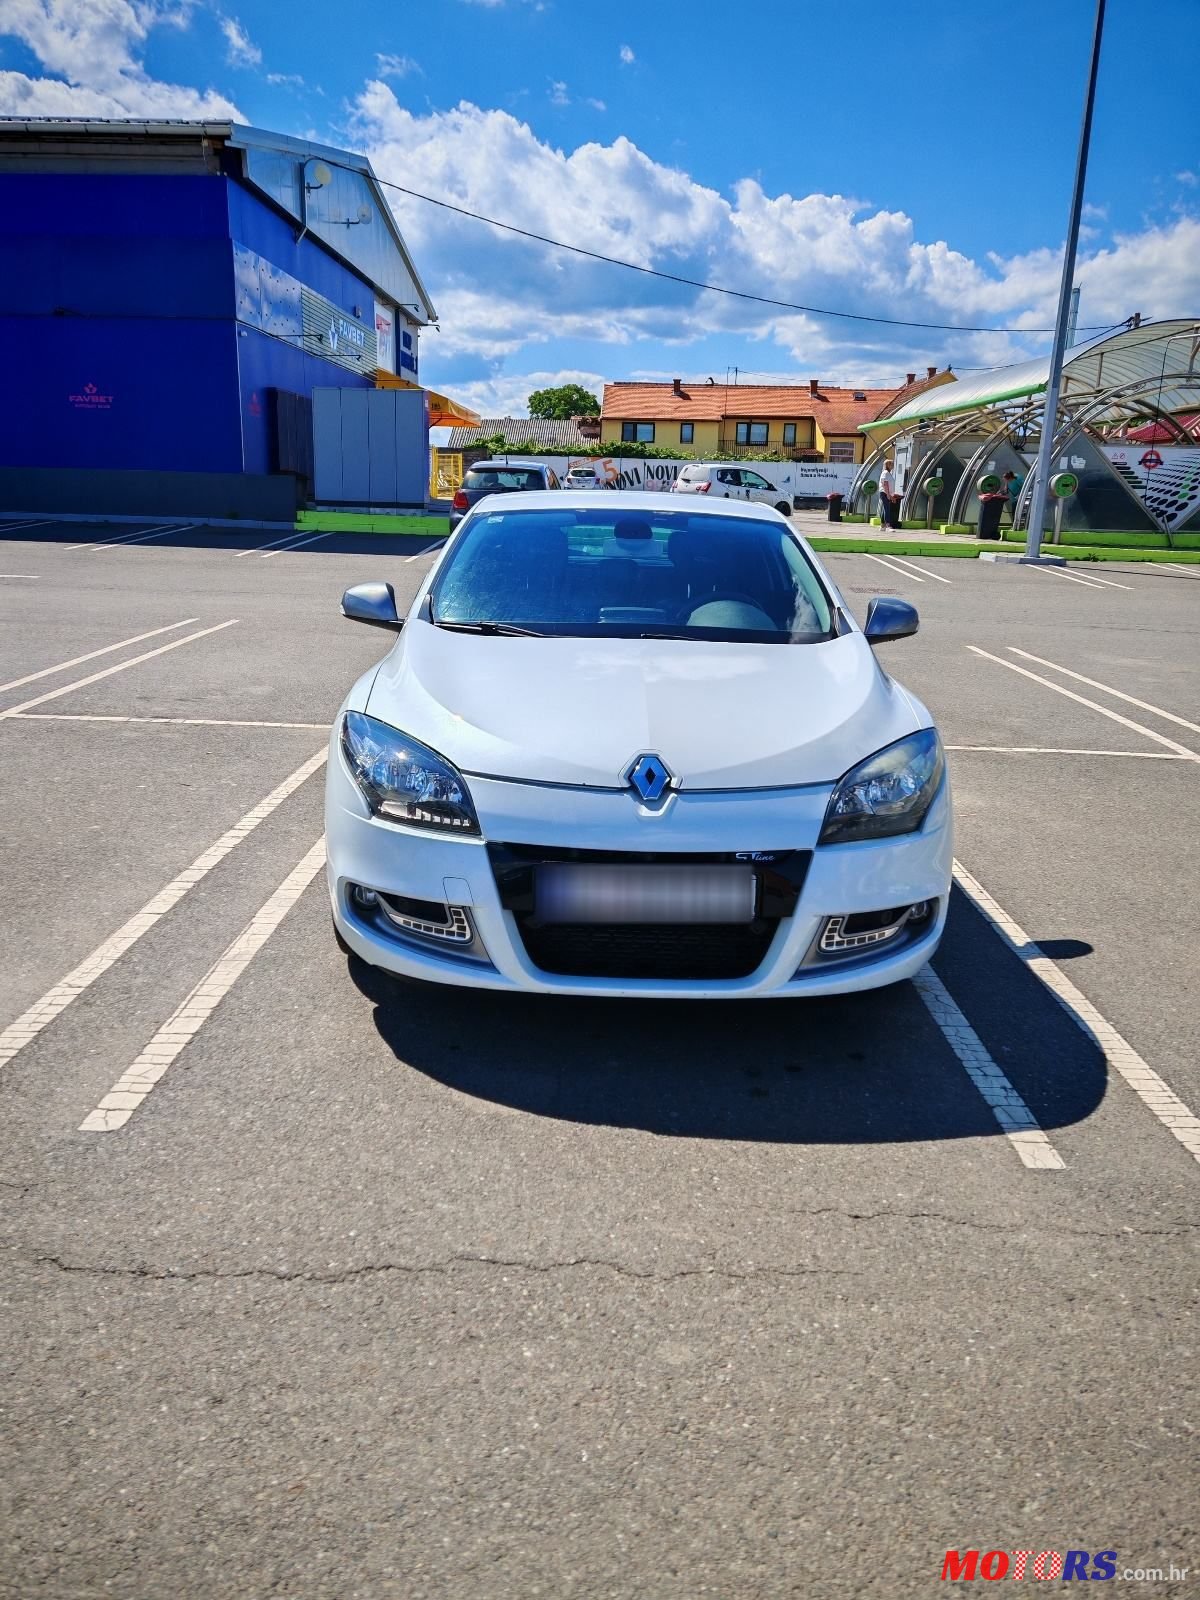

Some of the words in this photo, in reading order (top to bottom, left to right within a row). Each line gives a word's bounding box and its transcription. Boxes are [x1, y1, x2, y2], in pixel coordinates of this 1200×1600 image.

[339, 319, 365, 348] FAVBET
[69, 395, 113, 403] FAVBET
[645, 464, 678, 481] NOVI
